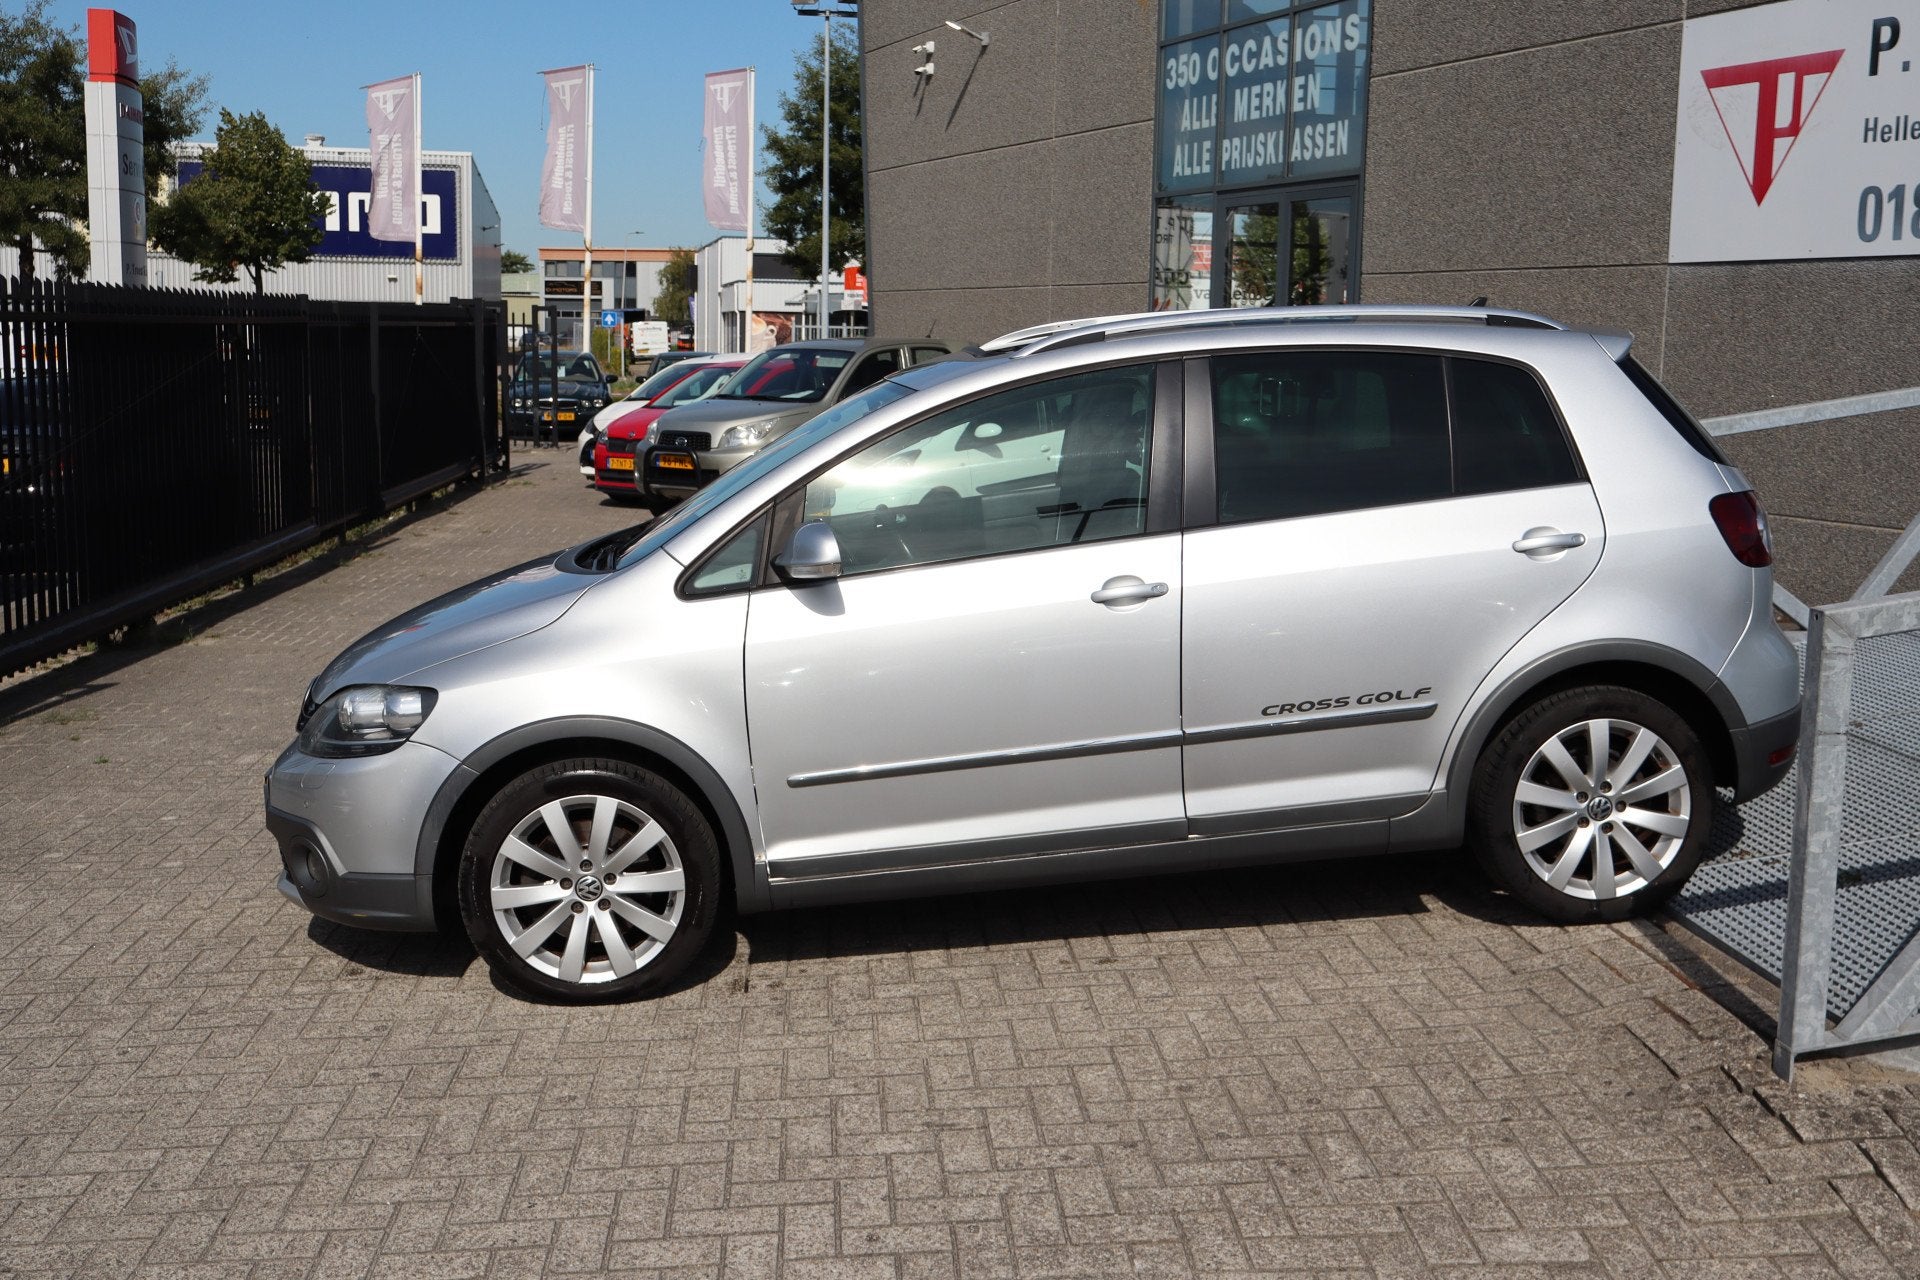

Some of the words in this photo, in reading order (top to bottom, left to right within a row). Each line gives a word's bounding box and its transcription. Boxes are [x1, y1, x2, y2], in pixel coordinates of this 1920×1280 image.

[1166, 52, 1201, 91] 350
[1206, 13, 1361, 81] OCCASIONS
[1868, 16, 1911, 77] P.
[1181, 93, 1218, 133] ALLE
[1234, 72, 1322, 123] MERKEN
[1863, 115, 1920, 144] Helle
[1173, 143, 1211, 178] ALLE
[1261, 695, 1351, 717] CROSS
[1356, 686, 1432, 705] GOLF
